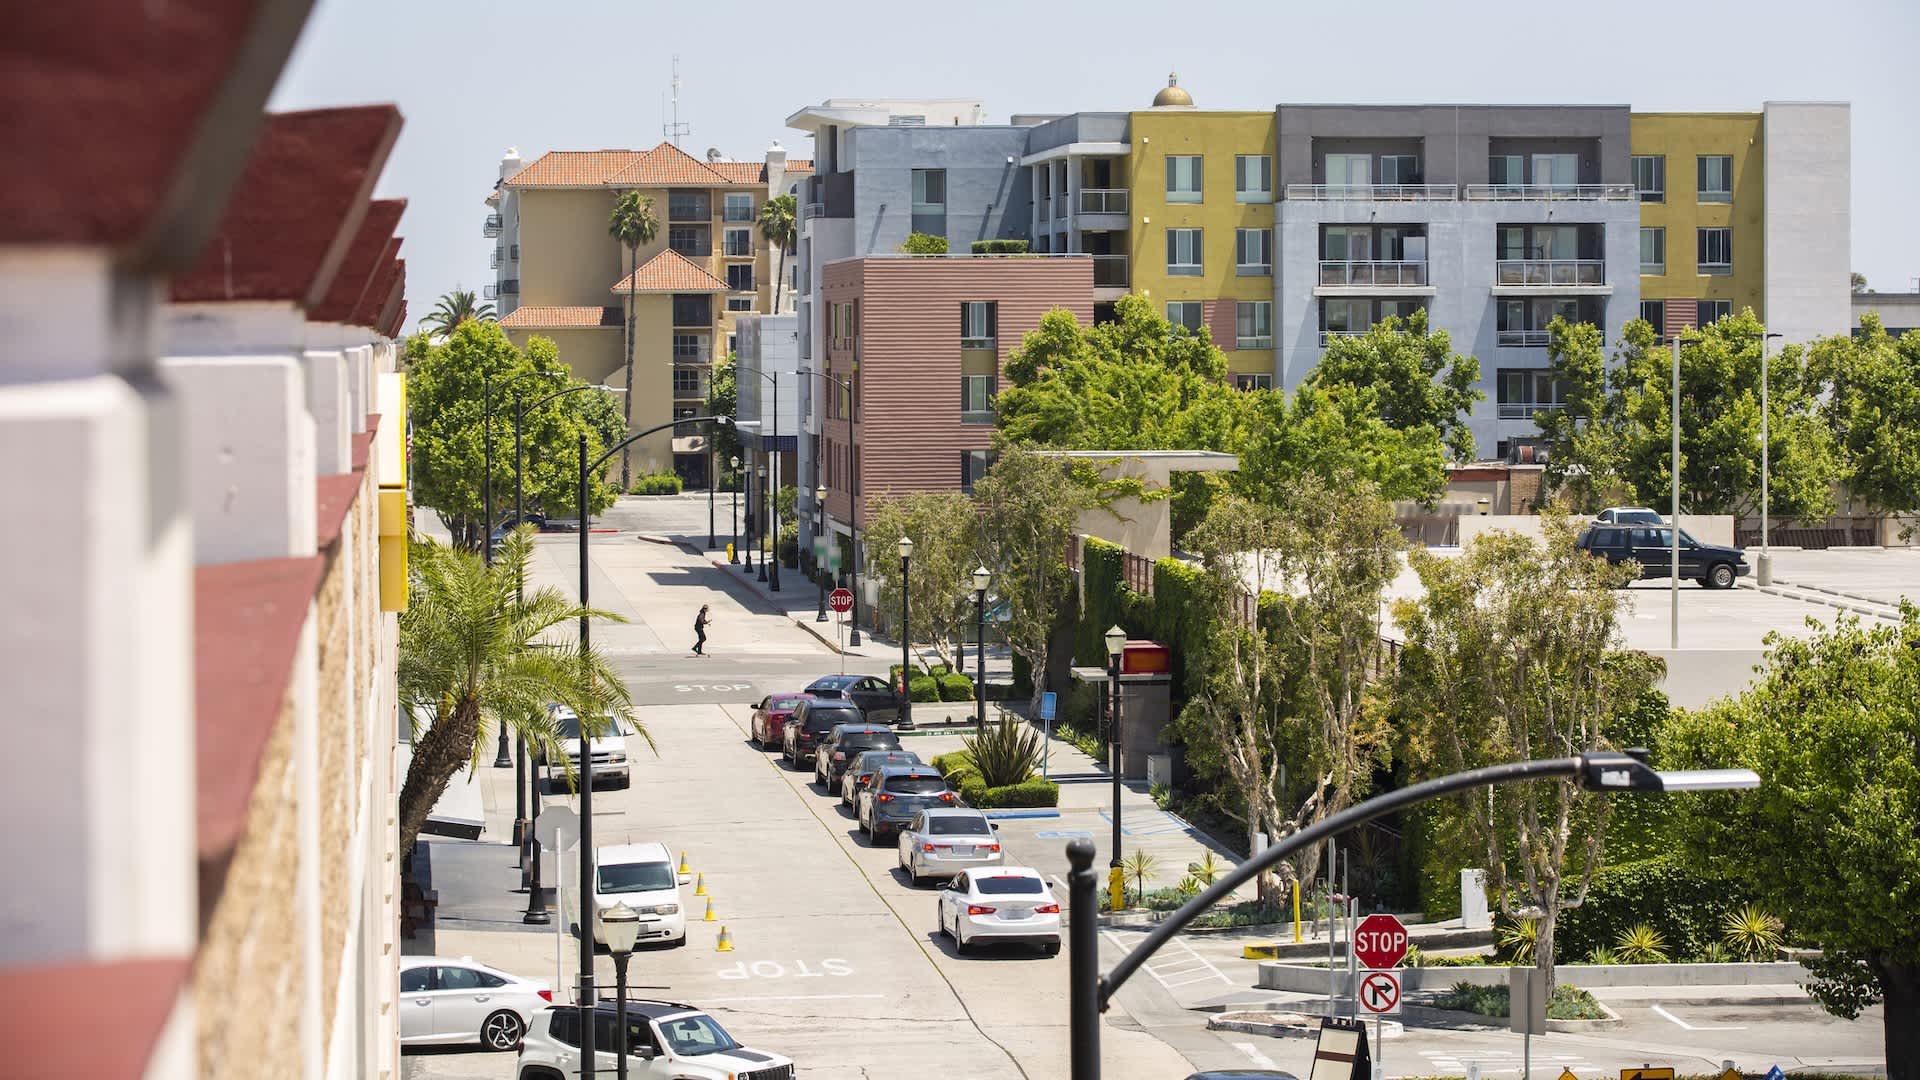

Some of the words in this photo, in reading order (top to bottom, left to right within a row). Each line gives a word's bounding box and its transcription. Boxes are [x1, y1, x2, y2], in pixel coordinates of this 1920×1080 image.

[831, 595, 852, 605] STOP
[674, 684, 751, 692] STOP
[1357, 931, 1405, 953] STOP
[717, 958, 853, 980] STOP
